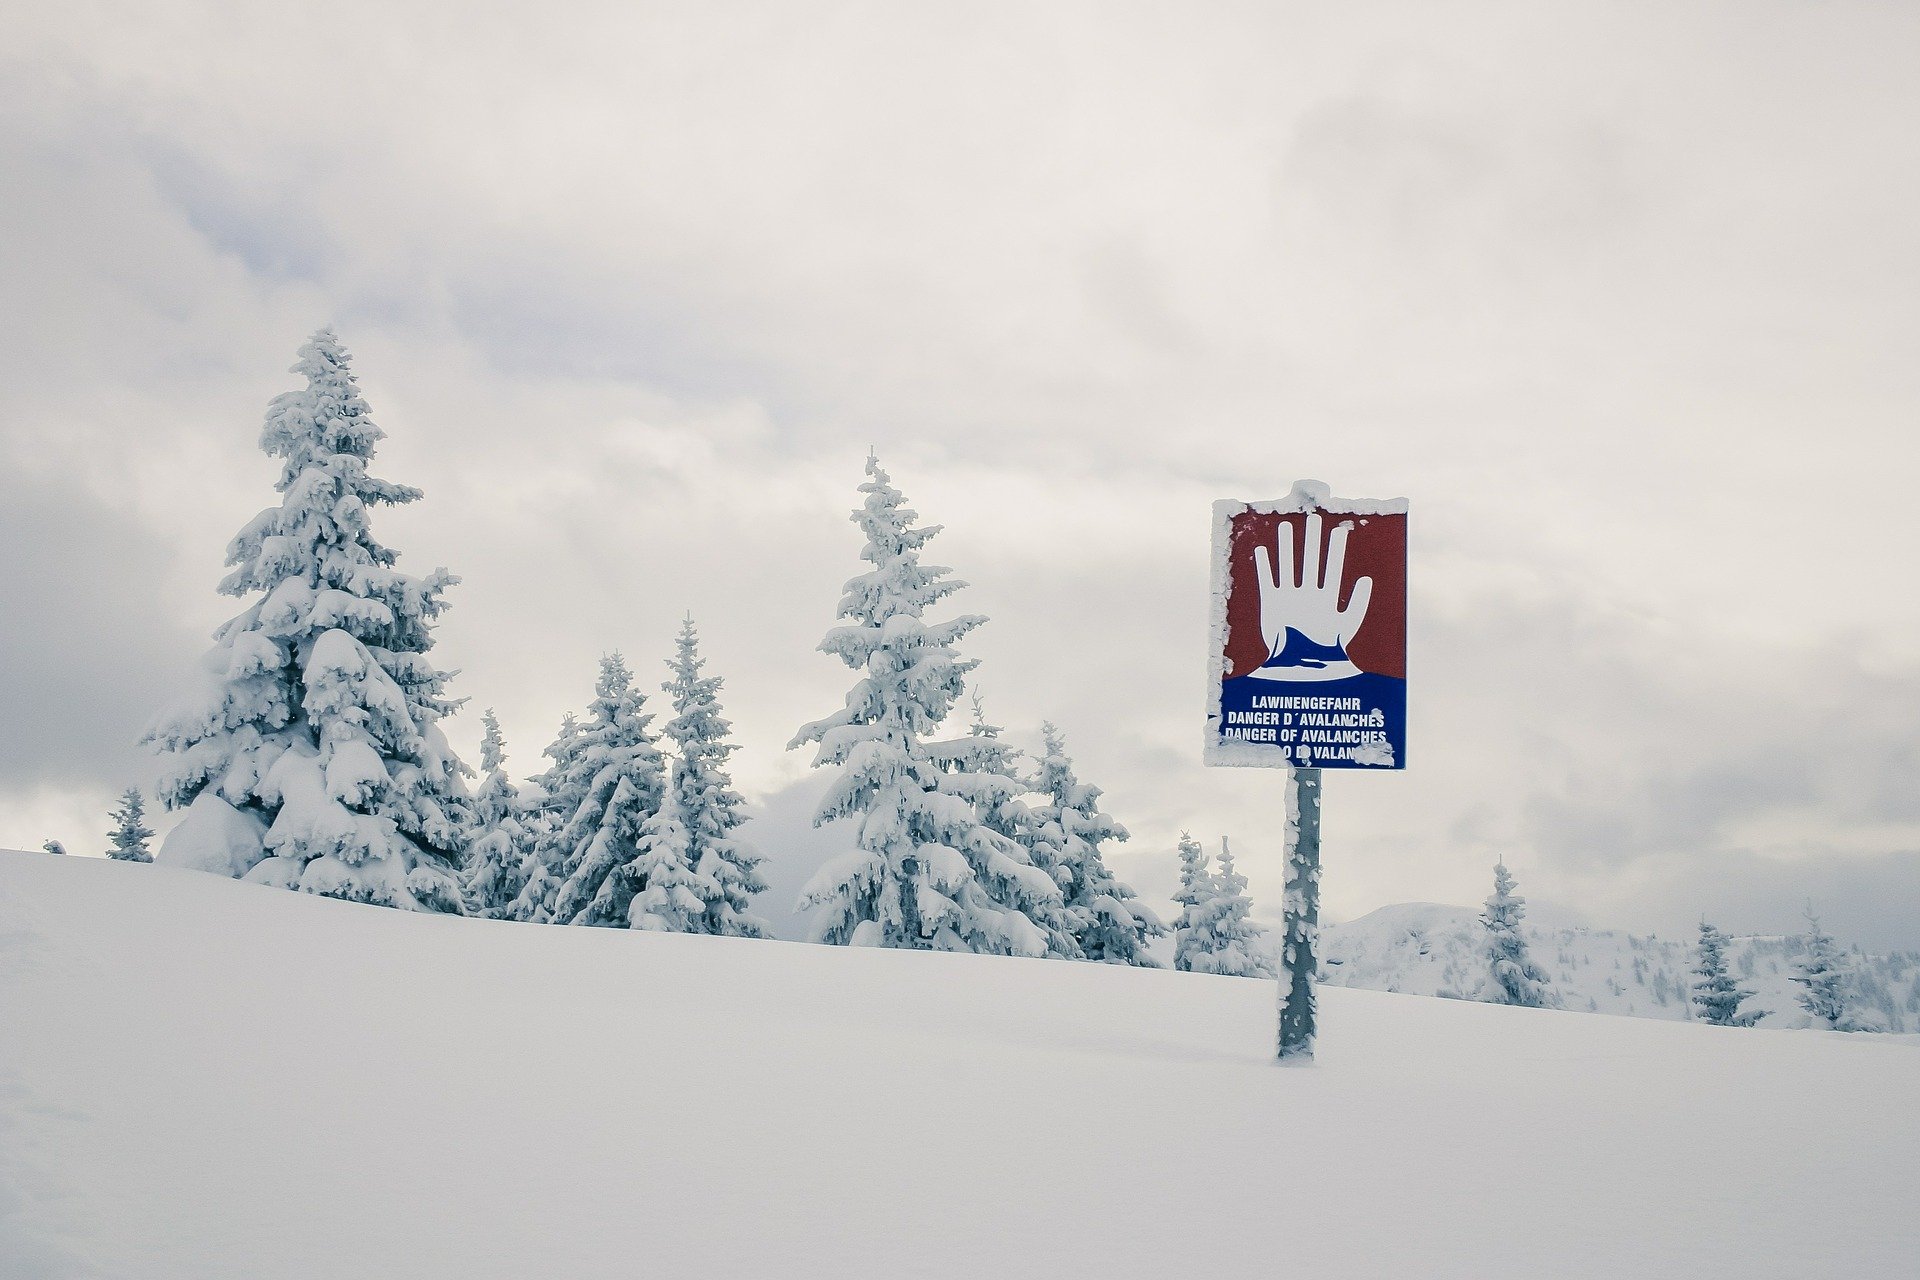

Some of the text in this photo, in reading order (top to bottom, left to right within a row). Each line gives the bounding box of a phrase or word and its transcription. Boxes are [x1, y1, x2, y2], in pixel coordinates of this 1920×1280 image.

[1252, 695, 1361, 711] LAWINENGEFAHR
[1228, 711, 1279, 725] DANGER
[1225, 727, 1387, 743] DANGER OF AVALANCHES
